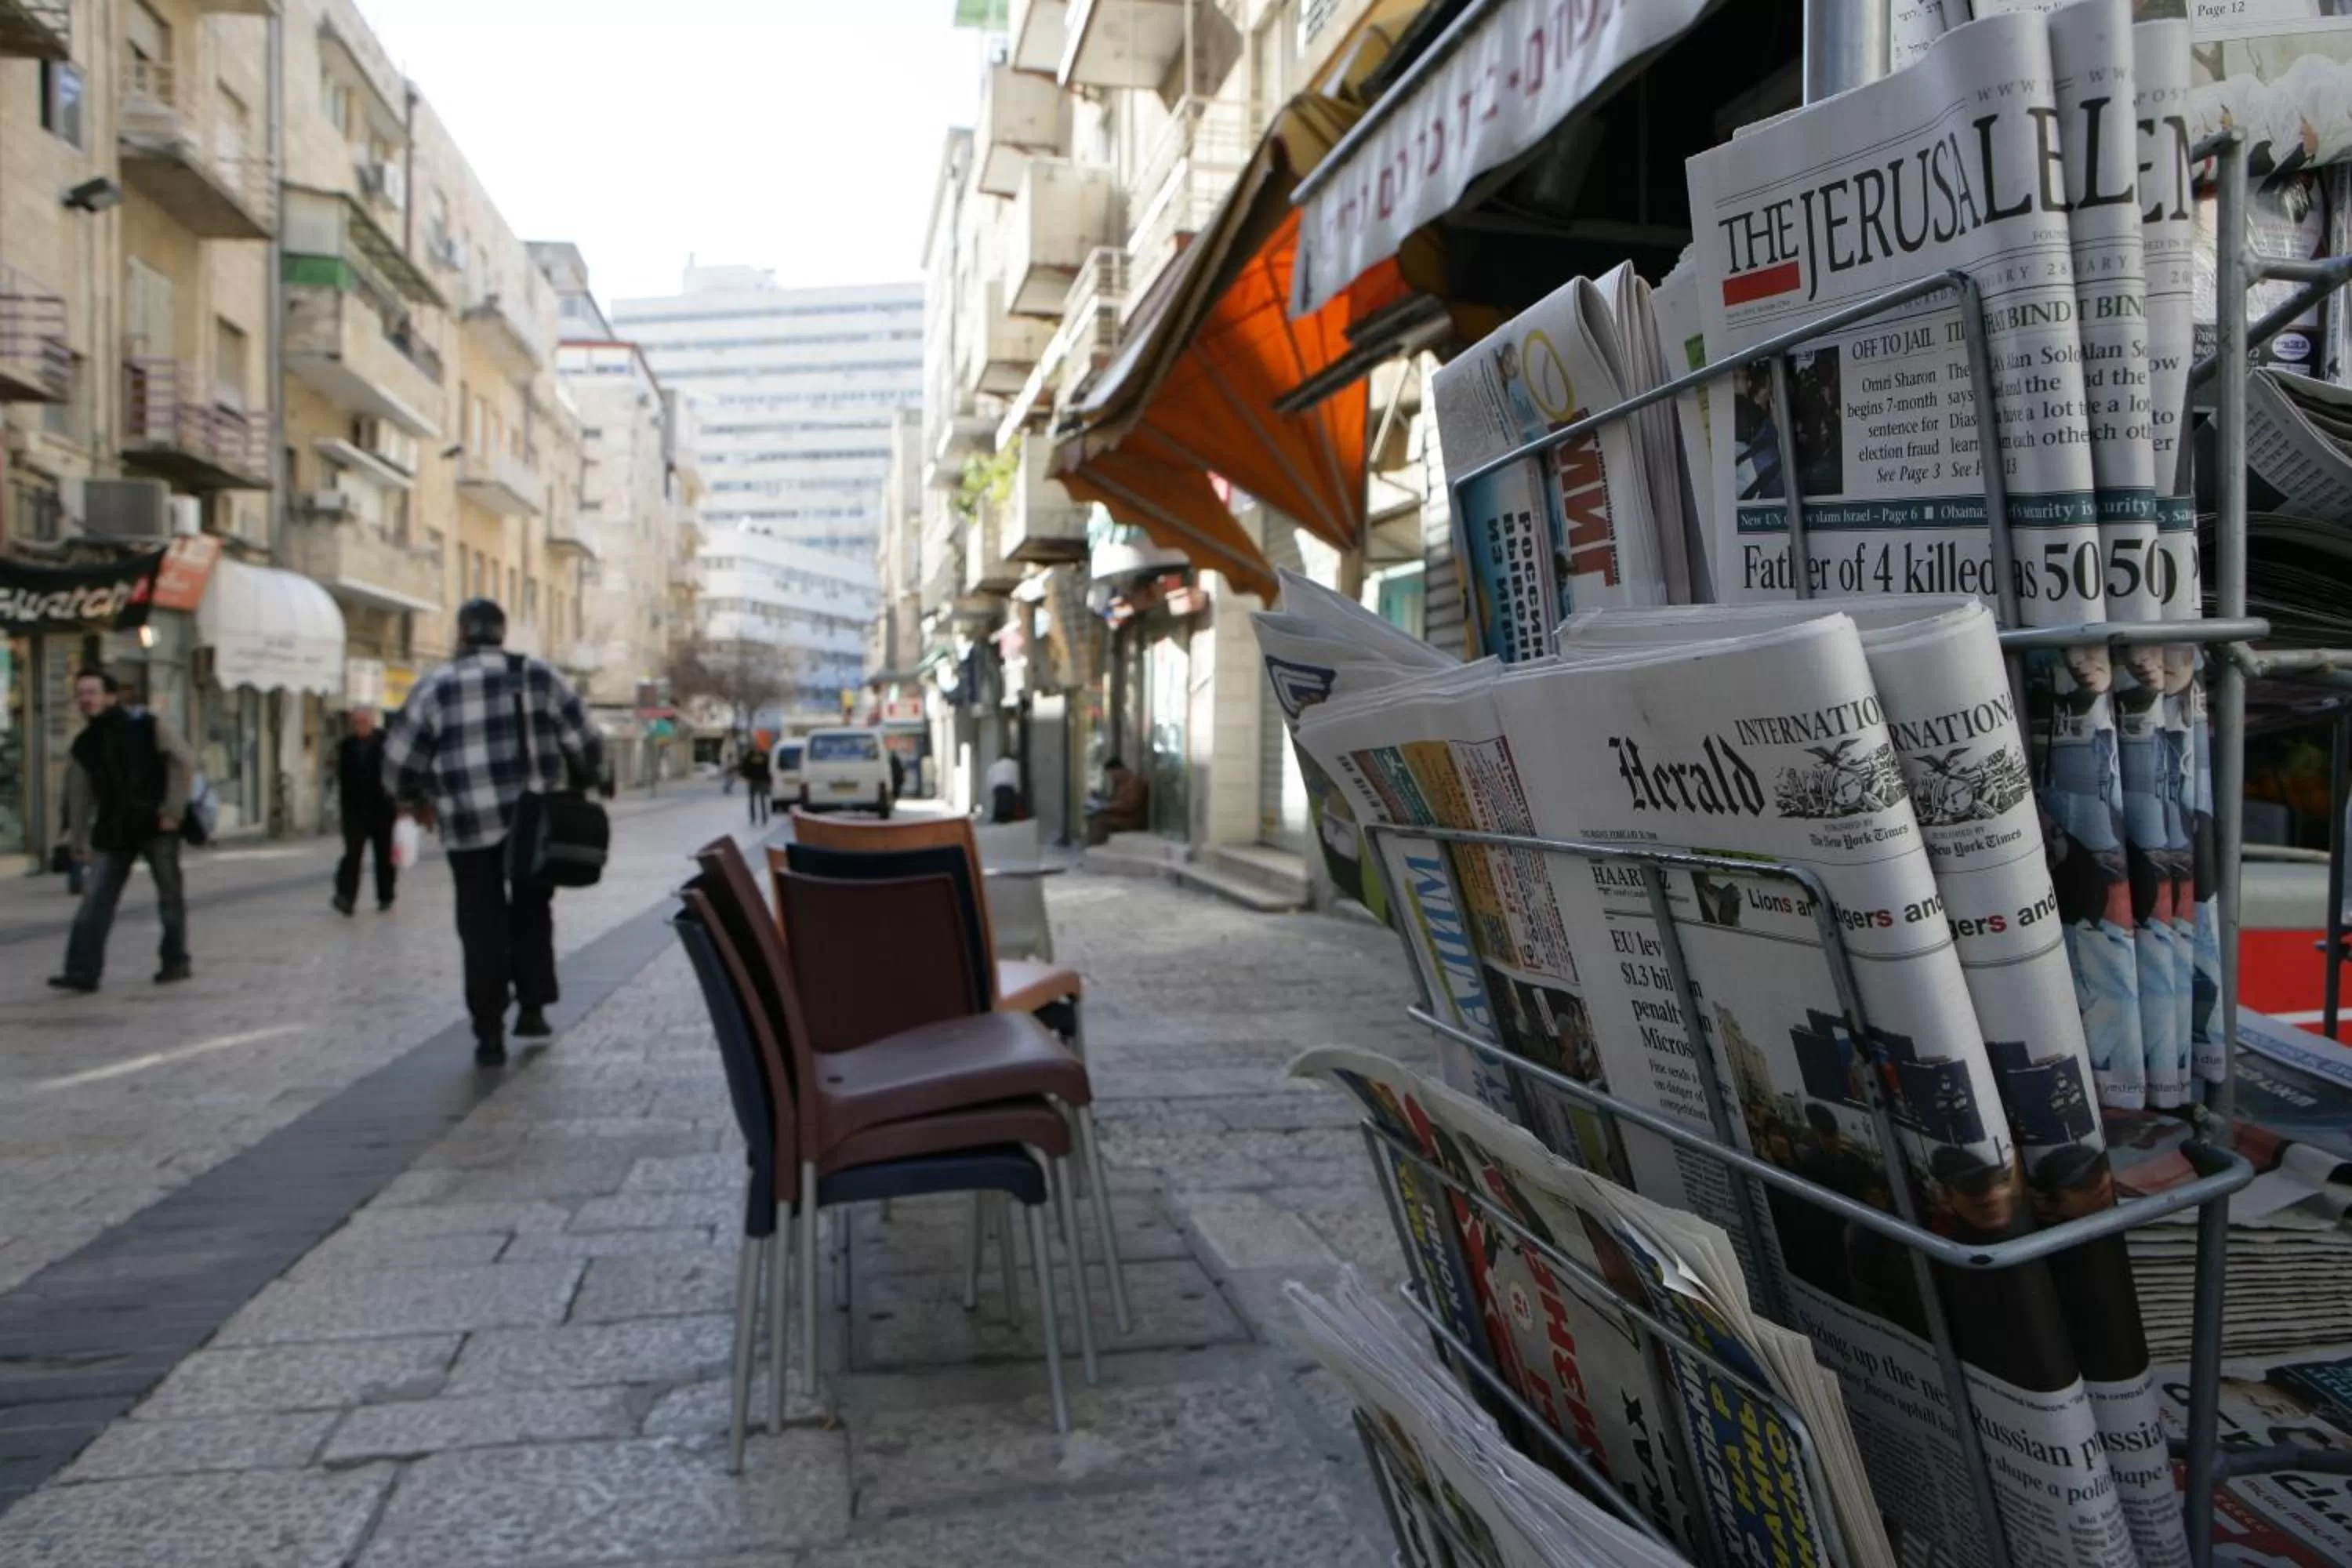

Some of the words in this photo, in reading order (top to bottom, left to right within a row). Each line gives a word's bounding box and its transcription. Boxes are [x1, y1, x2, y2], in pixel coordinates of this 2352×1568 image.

[2197, 3, 2226, 18] Page
[2230, 1, 2246, 13] 12
[1718, 198, 1800, 274] THE
[2007, 300, 2071, 331] BIND
[1852, 336, 1878, 361] OFF
[1881, 332, 1901, 355] TO
[1904, 326, 1936, 354] JAIL
[1894, 368, 1937, 388] Sharon
[2024, 376, 2061, 394] the
[2111, 365, 2147, 387] the
[1846, 400, 1883, 422] begins
[1886, 391, 1938, 412] 7-month
[2042, 401, 2074, 421] lot
[1868, 419, 1918, 439] sentence
[1922, 415, 1940, 433] for
[1857, 442, 1904, 463] election
[1906, 438, 1940, 457] fraud
[1876, 467, 1896, 485] See
[1899, 464, 1928, 485] Page
[1932, 462, 1942, 480] 3
[1740, 514, 1762, 527] New
[1764, 512, 1782, 526] UN
[1843, 507, 1871, 523] Israel
[1882, 507, 1908, 526] Page
[1910, 507, 1918, 521] 6
[2082, 499, 2093, 515] is
[1838, 541, 1867, 593] of
[1872, 542, 1894, 593] 4
[2043, 541, 2101, 602] 50
[1608, 733, 1766, 818] Herald
[1842, 831, 1873, 851] York
[1873, 823, 1911, 842] Times
[1954, 839, 1986, 858] York
[1984, 828, 2023, 850] Times
[1747, 887, 1791, 915] Lions
[1610, 928, 1635, 955] EU
[1852, 1344, 1879, 1378] up
[1881, 1354, 1918, 1392] the
[1969, 1405, 2074, 1468] Russian
